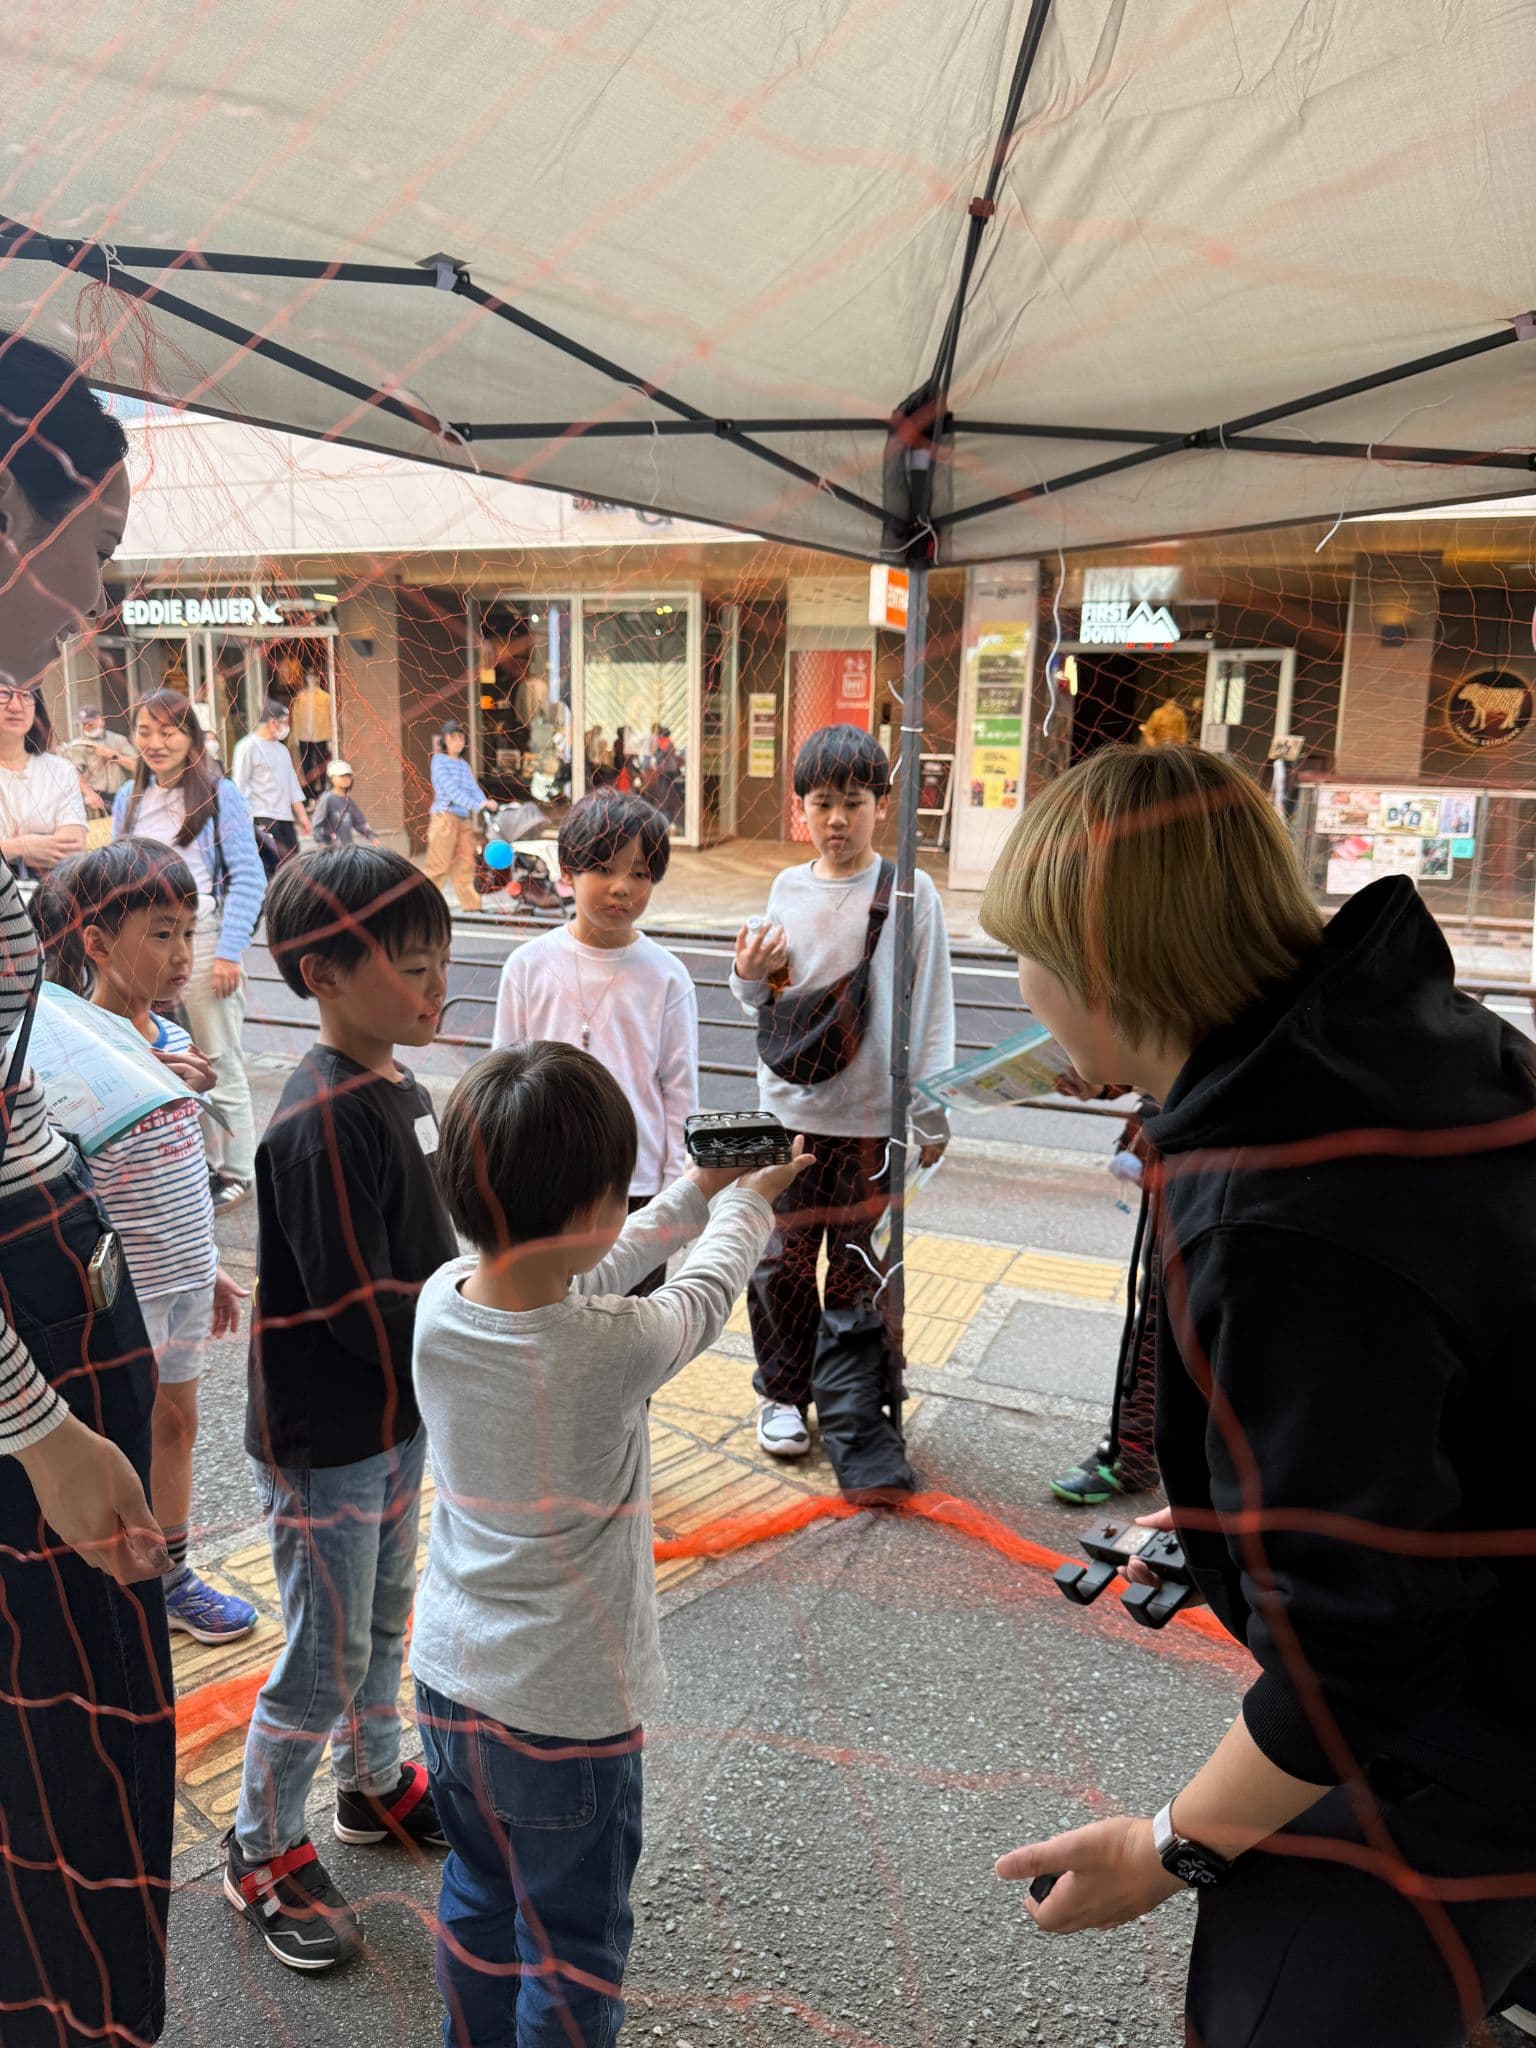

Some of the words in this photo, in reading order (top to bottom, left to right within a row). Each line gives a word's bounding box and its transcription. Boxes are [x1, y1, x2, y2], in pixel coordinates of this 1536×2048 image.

[122, 599, 182, 624] EDDIE
[185, 598, 255, 624] BAUER
[1082, 602, 1130, 622] FIRST
[1080, 626, 1127, 643] DOWN
